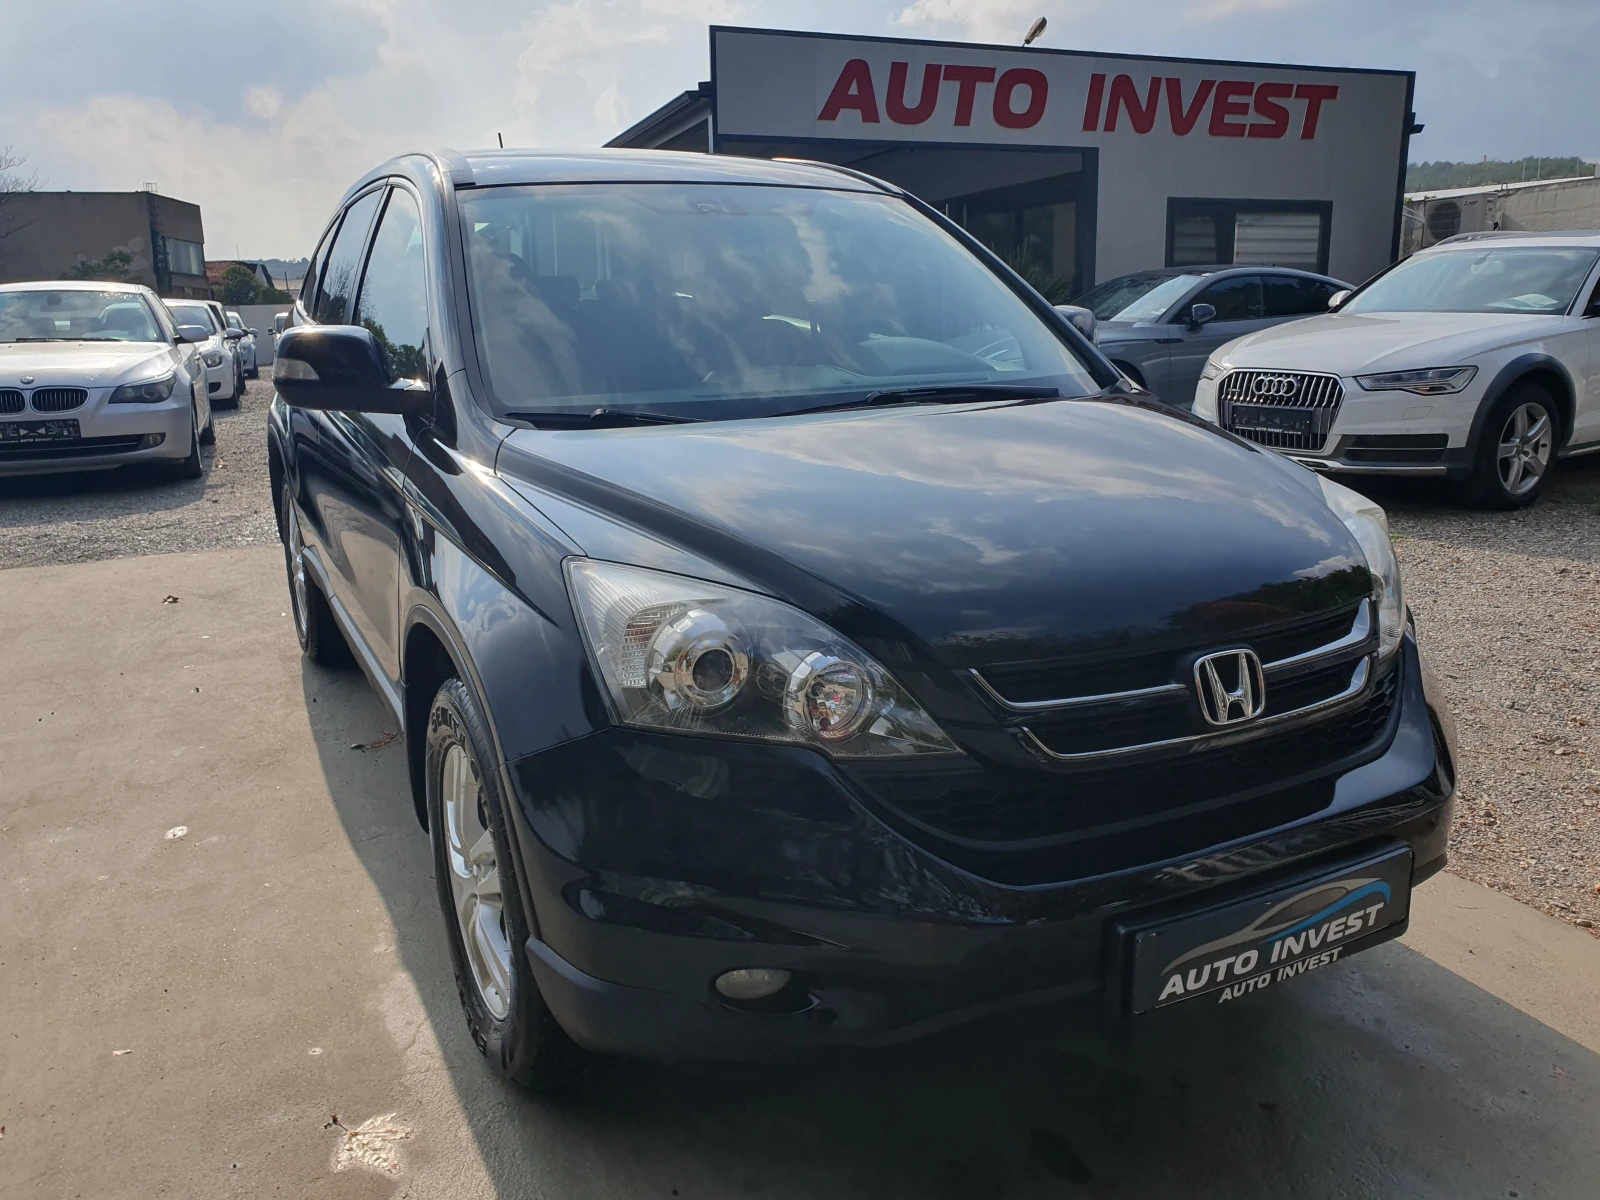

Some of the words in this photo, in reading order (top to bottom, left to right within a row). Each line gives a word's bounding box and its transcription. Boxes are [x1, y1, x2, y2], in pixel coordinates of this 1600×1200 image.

[817, 58, 1049, 130] AUTO
[1082, 73, 1339, 140] INVEST
[1158, 950, 1259, 1001] AUTO
[1270, 902, 1384, 964] INVEST
[1218, 974, 1270, 1003] AUTO
[1277, 947, 1342, 981] INVEST
